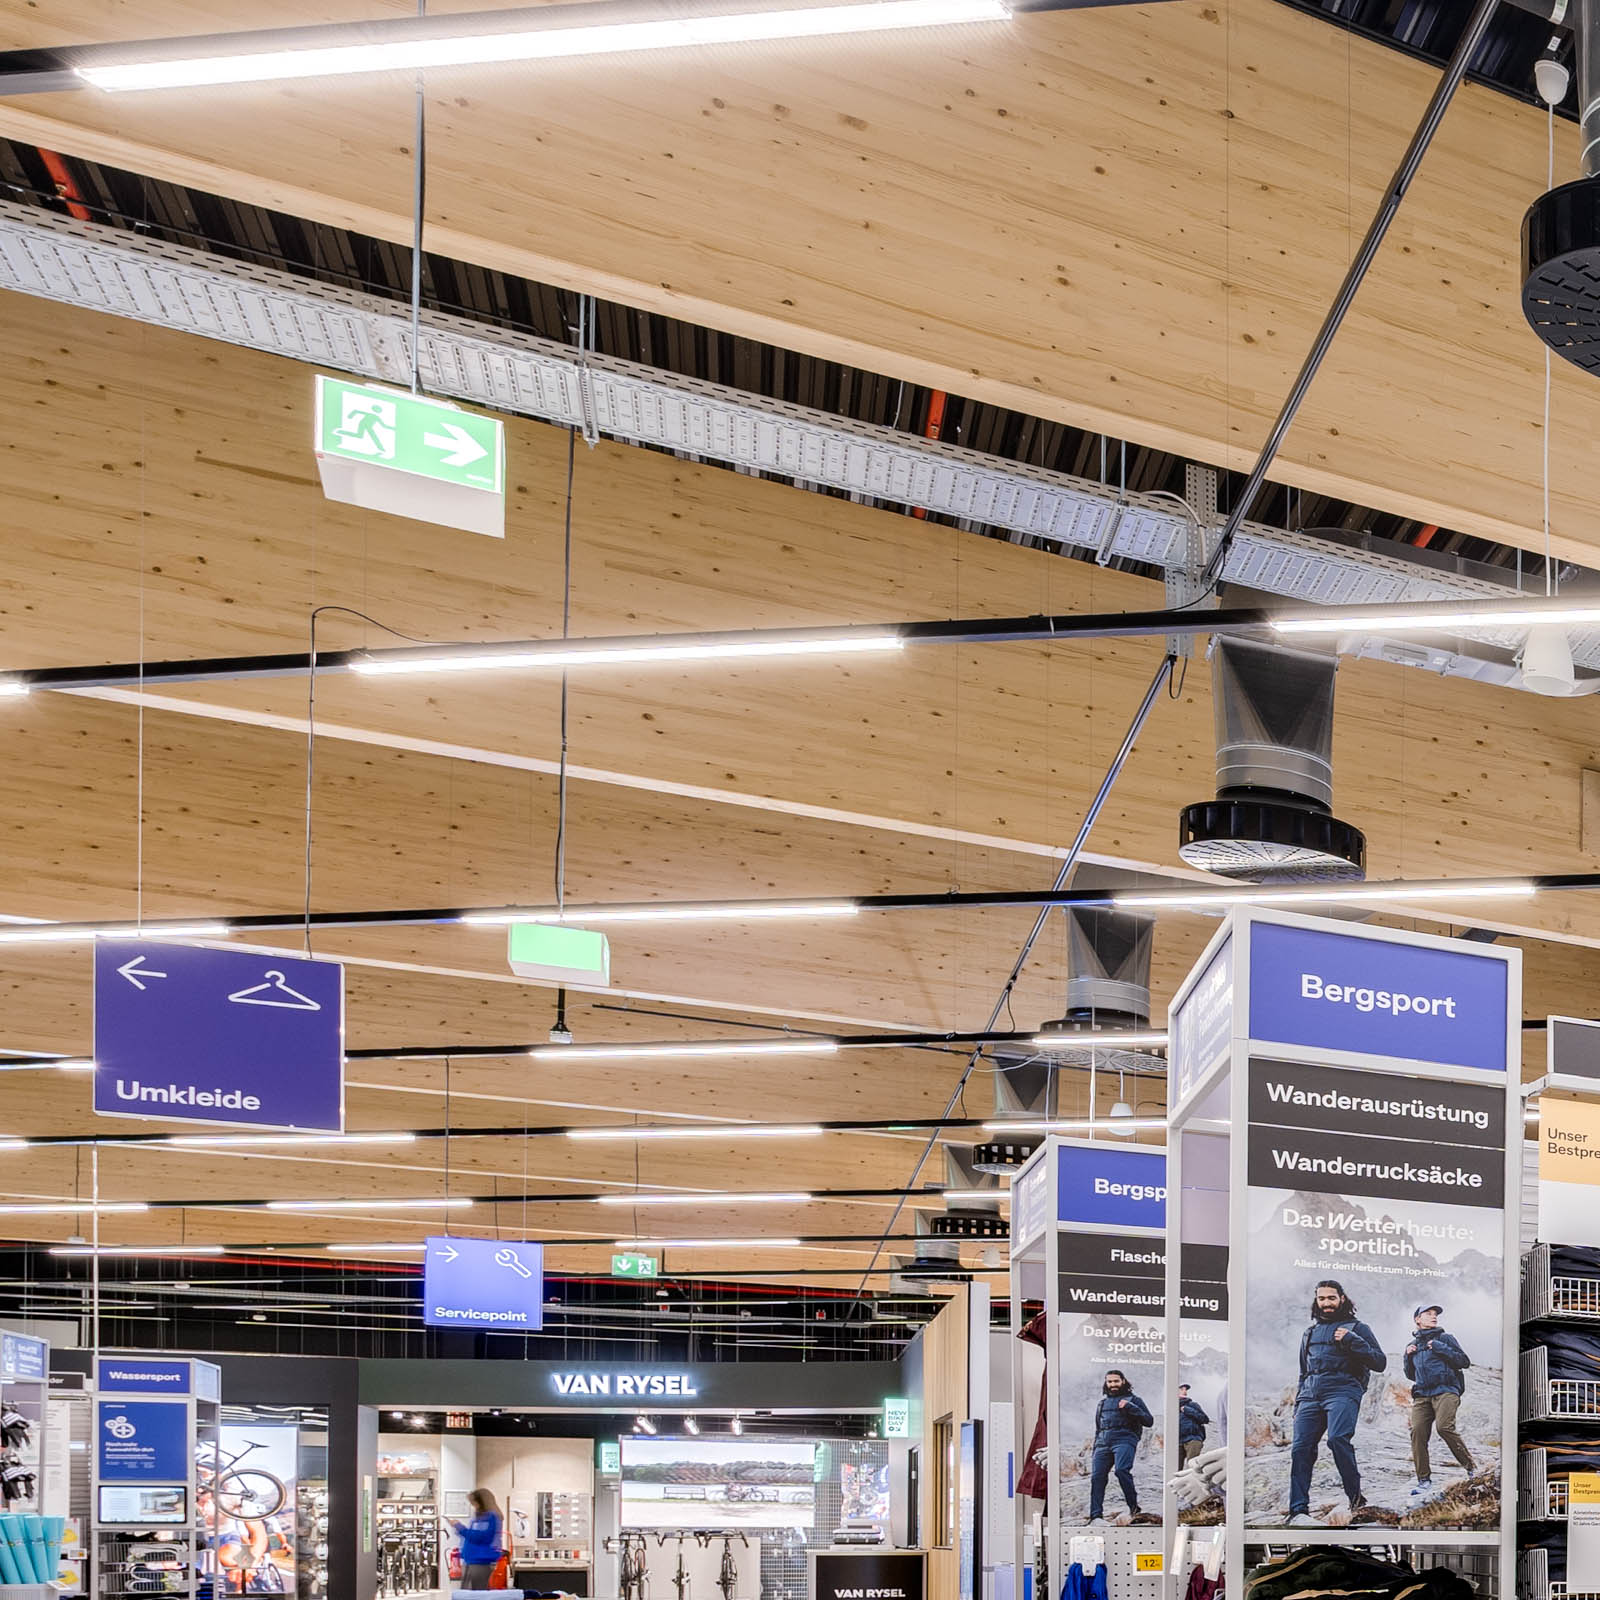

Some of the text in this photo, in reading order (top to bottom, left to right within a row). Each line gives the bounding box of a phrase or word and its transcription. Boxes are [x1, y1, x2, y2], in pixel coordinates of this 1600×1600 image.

[1301, 973, 1456, 1018] Bergsport
[116, 1079, 261, 1111] Umkleide
[1266, 1082, 1489, 1129] Wanderausrüstung
[1547, 1127, 1588, 1143] Unser
[1272, 1149, 1483, 1187] Wanderrucksäcke
[1094, 1177, 1167, 1202] Bergsp
[1282, 1208, 1474, 1241] Das Wetter heute:
[1111, 1249, 1167, 1265] Flasche
[1318, 1236, 1419, 1258] sportlich.
[1293, 1259, 1316, 1270] Alles
[1318, 1260, 1332, 1270] für
[1333, 1261, 1350, 1271] den
[1351, 1262, 1382, 1273] Herbst
[1384, 1266, 1402, 1275] zum
[1070, 1288, 1219, 1312] Wanderausrstung
[434, 1307, 528, 1322] Servicepoint
[1083, 1325, 1111, 1338] Das
[1113, 1326, 1165, 1340] Wetter
[109, 1371, 181, 1382] Wassersport
[552, 1374, 697, 1396] VAN RYSEL
[834, 1588, 906, 1598] VAN RYSEL
